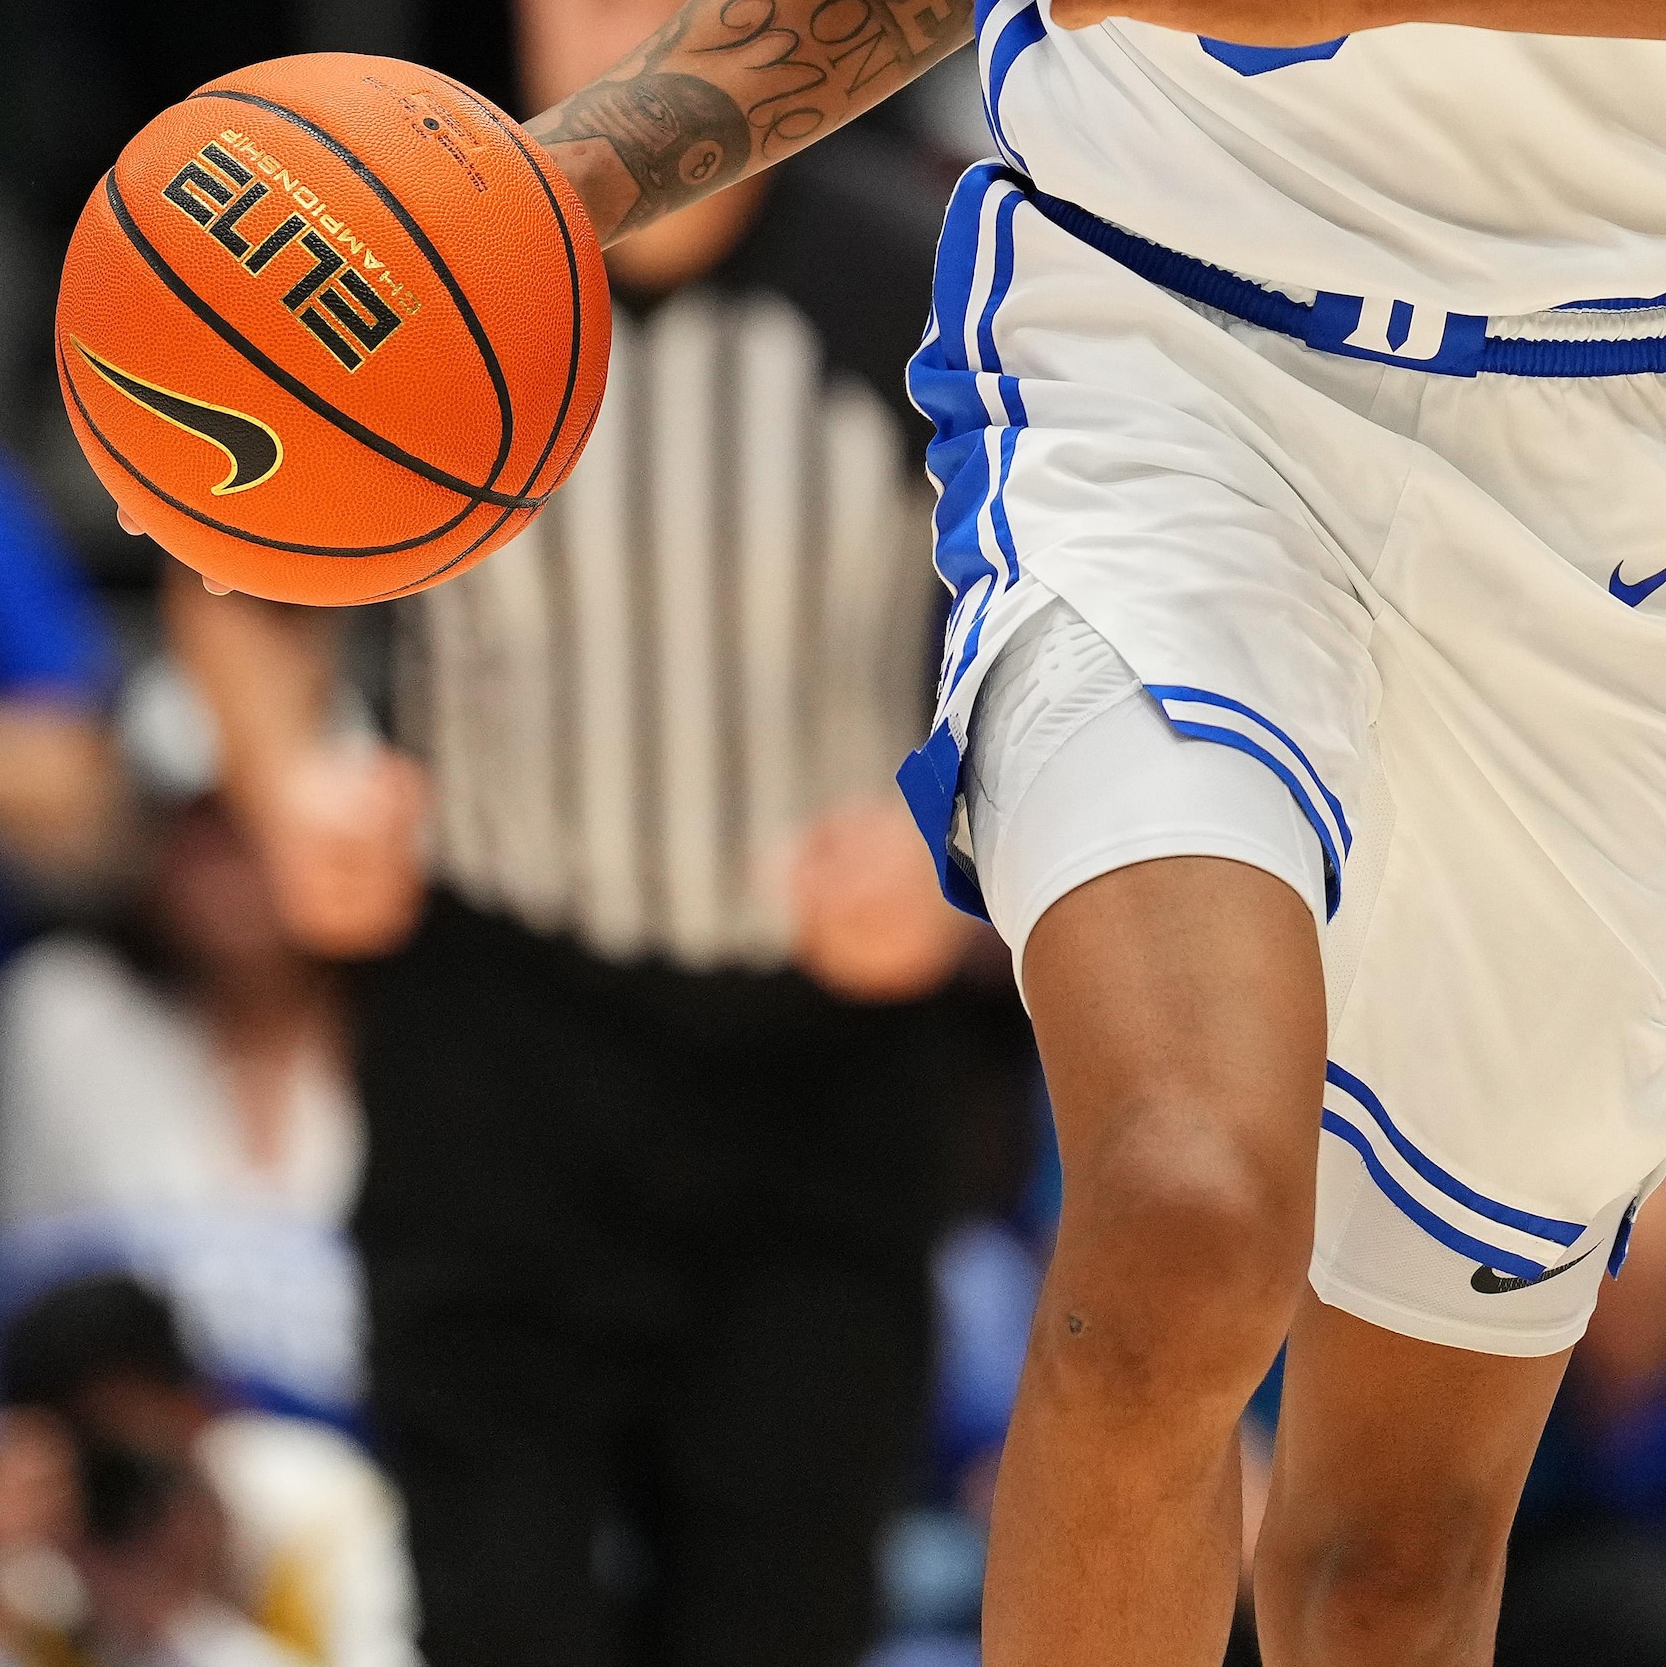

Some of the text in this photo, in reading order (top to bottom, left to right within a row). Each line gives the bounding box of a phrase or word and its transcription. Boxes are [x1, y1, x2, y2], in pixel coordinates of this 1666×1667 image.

[161, 140, 404, 374] ELITE
[220, 128, 423, 315] CHAMPIONSHIP
[690, 151, 717, 180] 8
